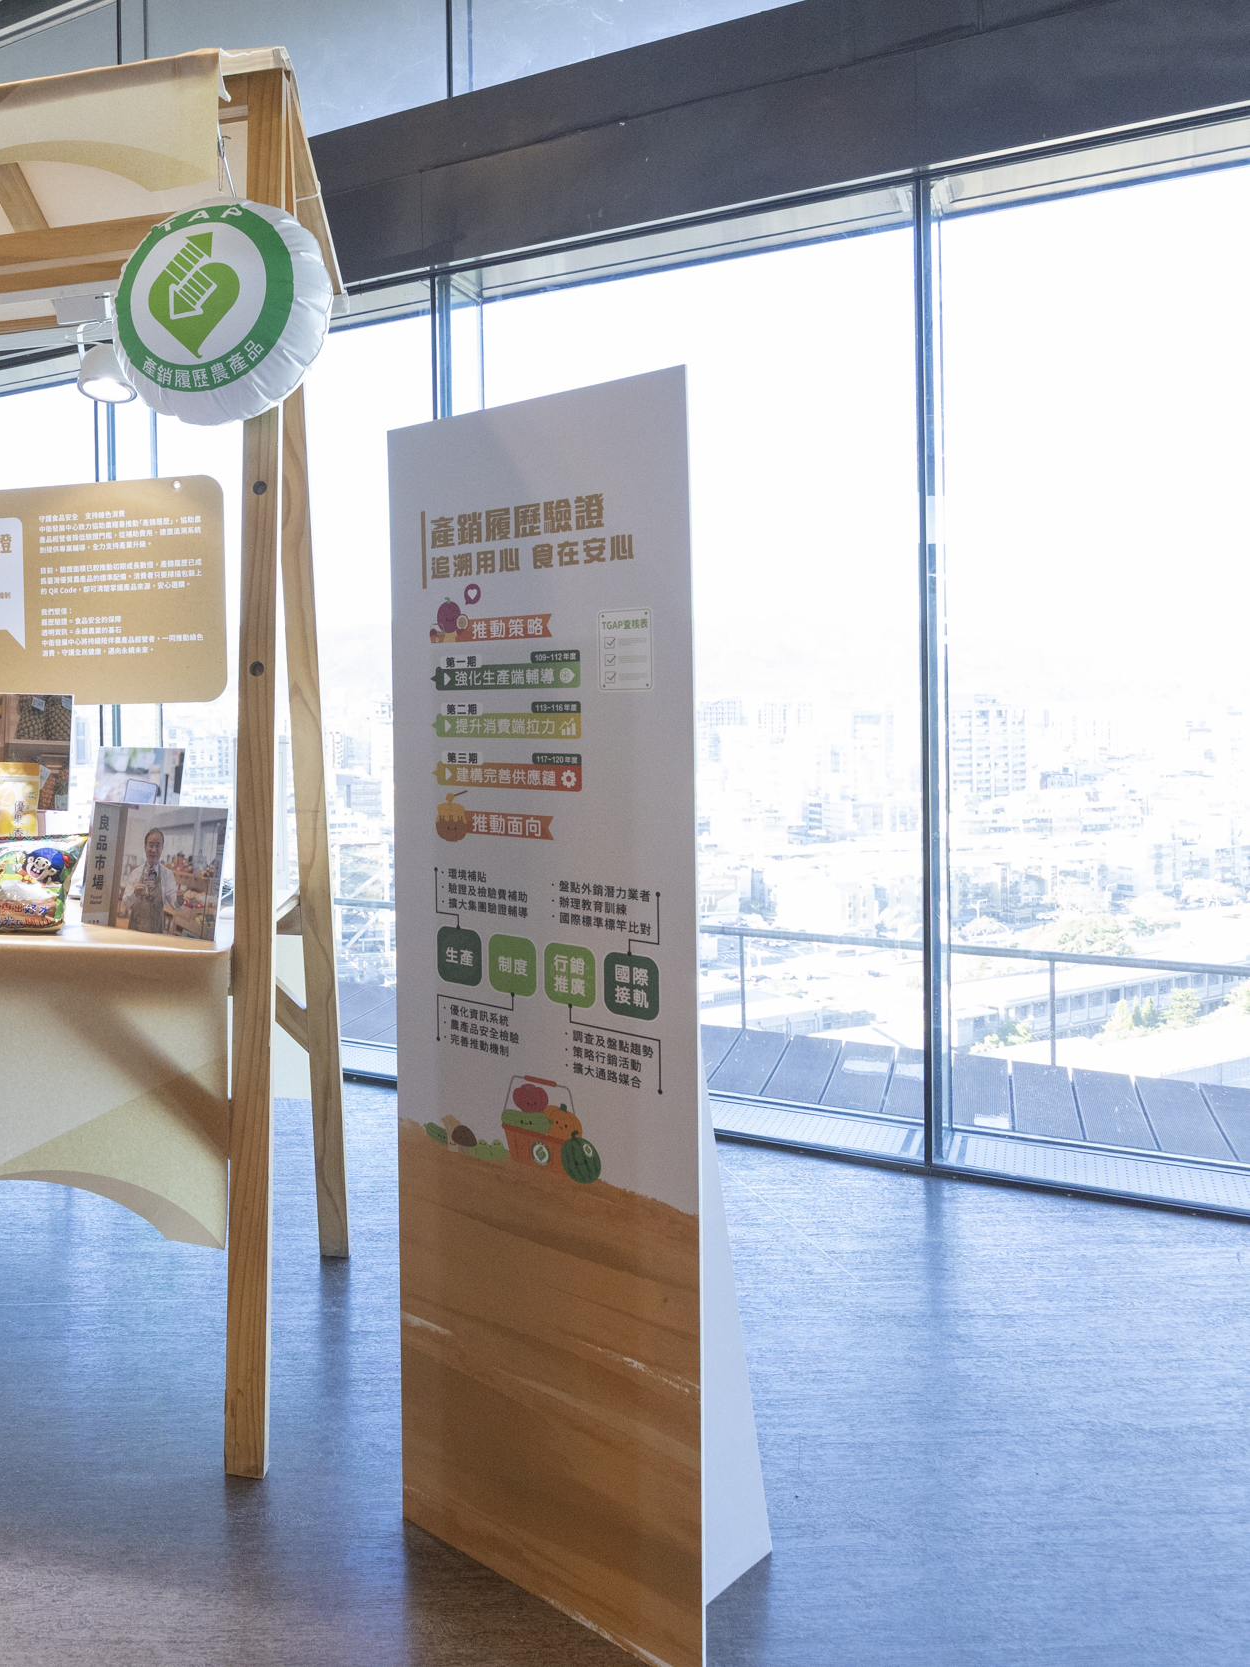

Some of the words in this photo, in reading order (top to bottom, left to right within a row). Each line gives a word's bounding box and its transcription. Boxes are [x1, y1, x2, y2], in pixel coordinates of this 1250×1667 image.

[158, 207, 242, 231] TAP
[142, 339, 264, 389] 產銷履歷農產品
[430, 493, 605, 549] 產銷履歷驗證
[431, 547, 520, 580] 追溯用心
[532, 534, 634, 570] 食在安心
[48, 587, 59, 596] QR
[472, 617, 544, 640] 推動策略
[601, 618, 649, 630] TGAP查核表
[445, 656, 477, 668] 第一期
[454, 668, 555, 687] 強化生產端輔導
[446, 703, 477, 715] 第二期
[455, 718, 555, 735] 提升消費端拉力
[447, 752, 478, 764] 第三期
[456, 767, 557, 787] 建構完善供應鏈
[472, 813, 541, 837] 推動面向
[92, 814, 109, 890] 良品市場
[448, 868, 487, 883] 環境補貼
[448, 882, 528, 903] 驗證及檢驗費補助
[559, 880, 651, 903] 盤點外銷潛力業者
[448, 897, 528, 919] 擴大集團驗證輔導
[559, 896, 627, 916] 辦理教育訓練
[559, 912, 651, 936] 國際標準標竿比對
[445, 947, 474, 967] 生產
[498, 955, 528, 977] 制度
[553, 954, 585, 976] 行銷
[554, 974, 586, 997] 推廣
[614, 963, 649, 987] 國際
[614, 985, 649, 1009] 接軌
[450, 1004, 509, 1027] 優化資訊系統
[450, 1019, 519, 1045] 農產品安全檢驗
[450, 1034, 509, 1058] 完善推動機制
[572, 1029, 654, 1059] 調查及盤點趨勢
[572, 1046, 642, 1073] 策略行銷活動
[572, 1062, 642, 1089] 擴大通路媒合
